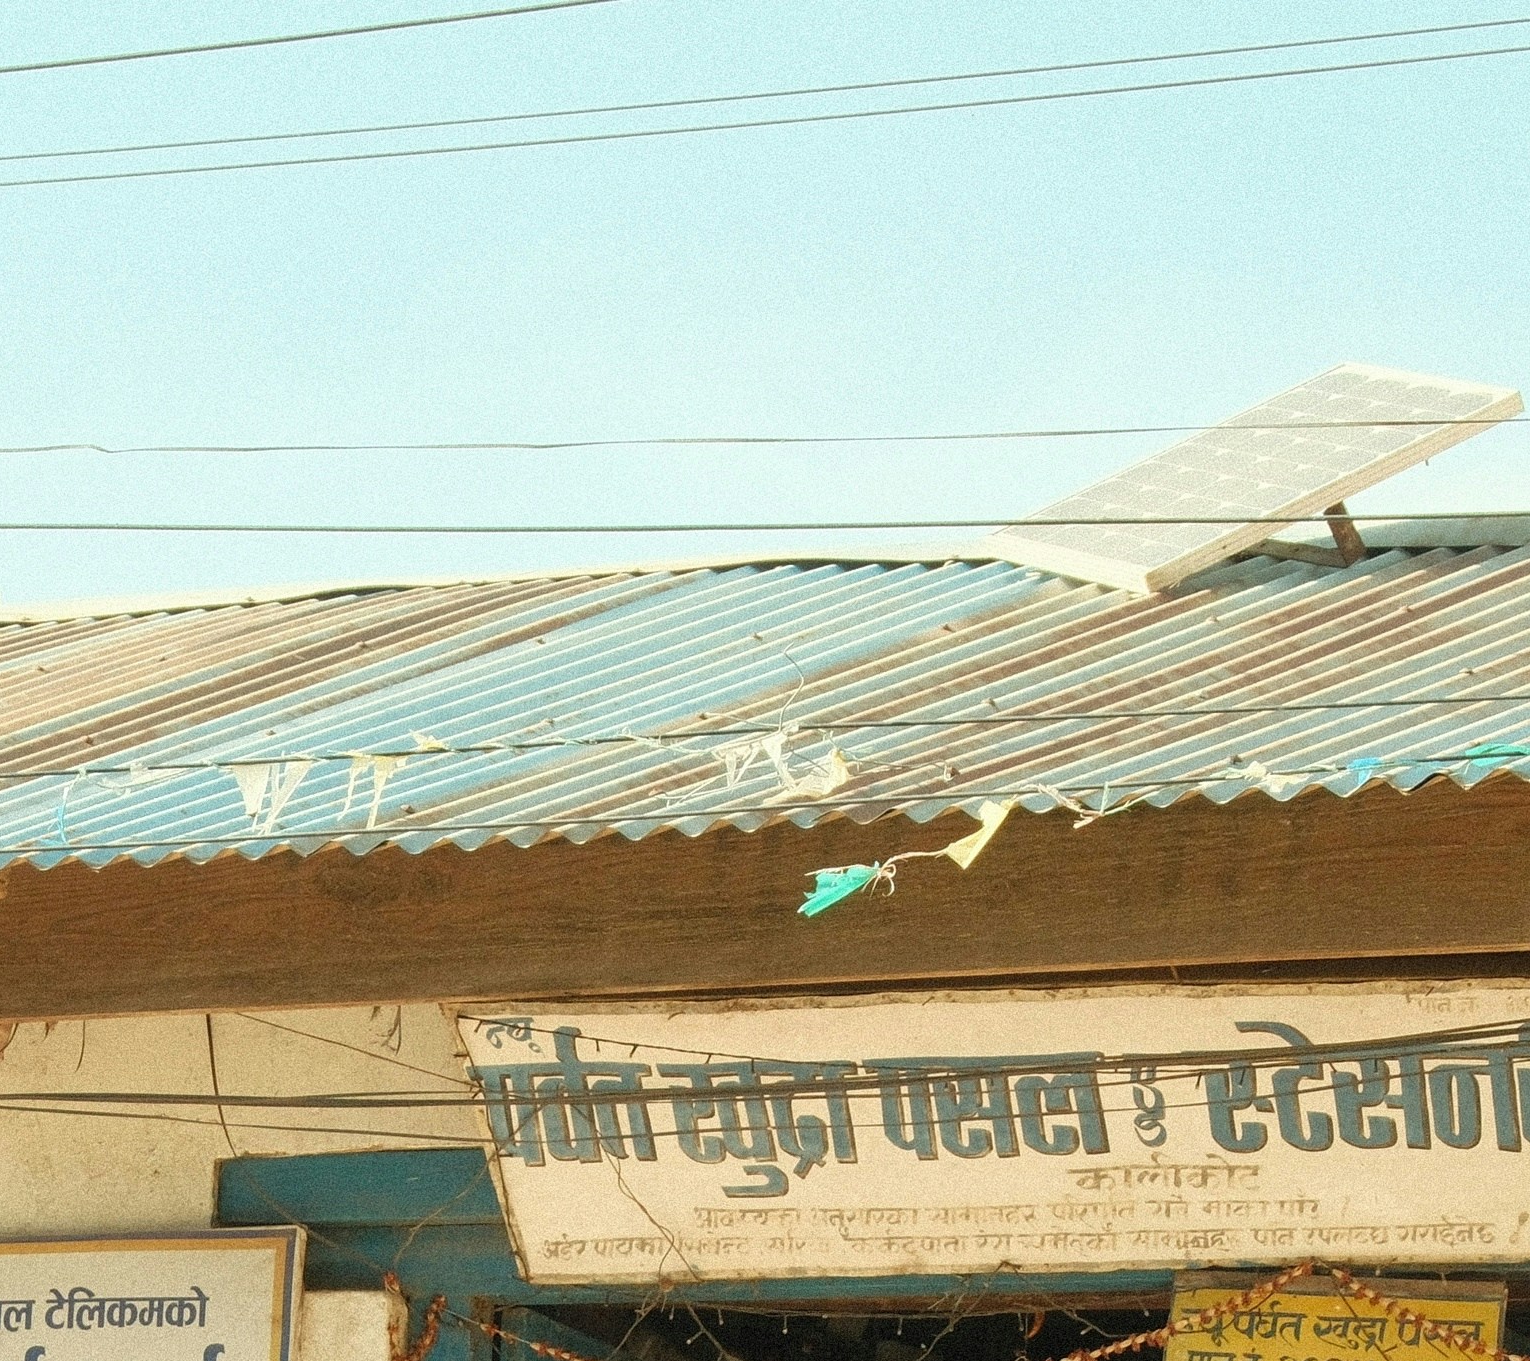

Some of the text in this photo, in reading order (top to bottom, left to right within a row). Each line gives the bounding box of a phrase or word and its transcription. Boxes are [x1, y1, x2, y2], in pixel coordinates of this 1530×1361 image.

[467, 1026, 657, 1167] पर्वत
[657, 1059, 858, 1198] खुद्रा
[862, 1050, 1111, 1163] पसल
[46, 1285, 209, 1332] टेलिकमको
